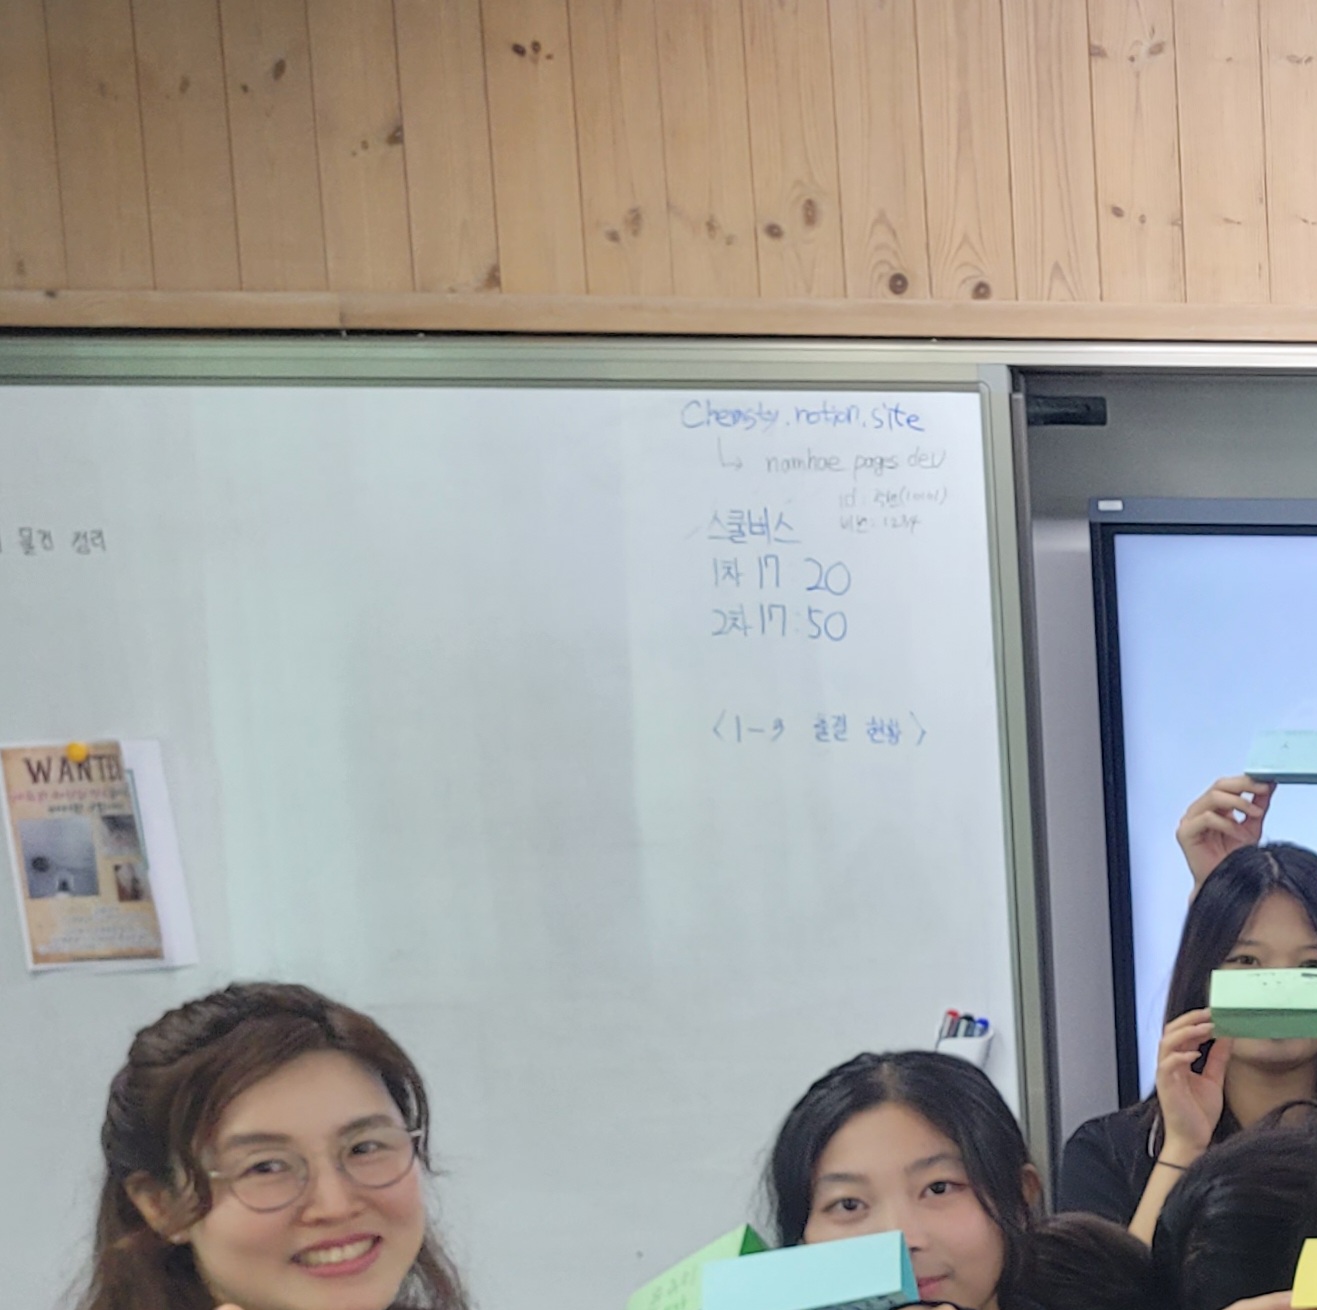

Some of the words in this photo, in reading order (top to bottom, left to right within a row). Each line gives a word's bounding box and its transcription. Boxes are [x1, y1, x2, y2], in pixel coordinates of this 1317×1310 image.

[707, 507, 802, 545] 스쿨버스
[712, 556, 743, 588] 1차
[711, 603, 753, 637] 2차
